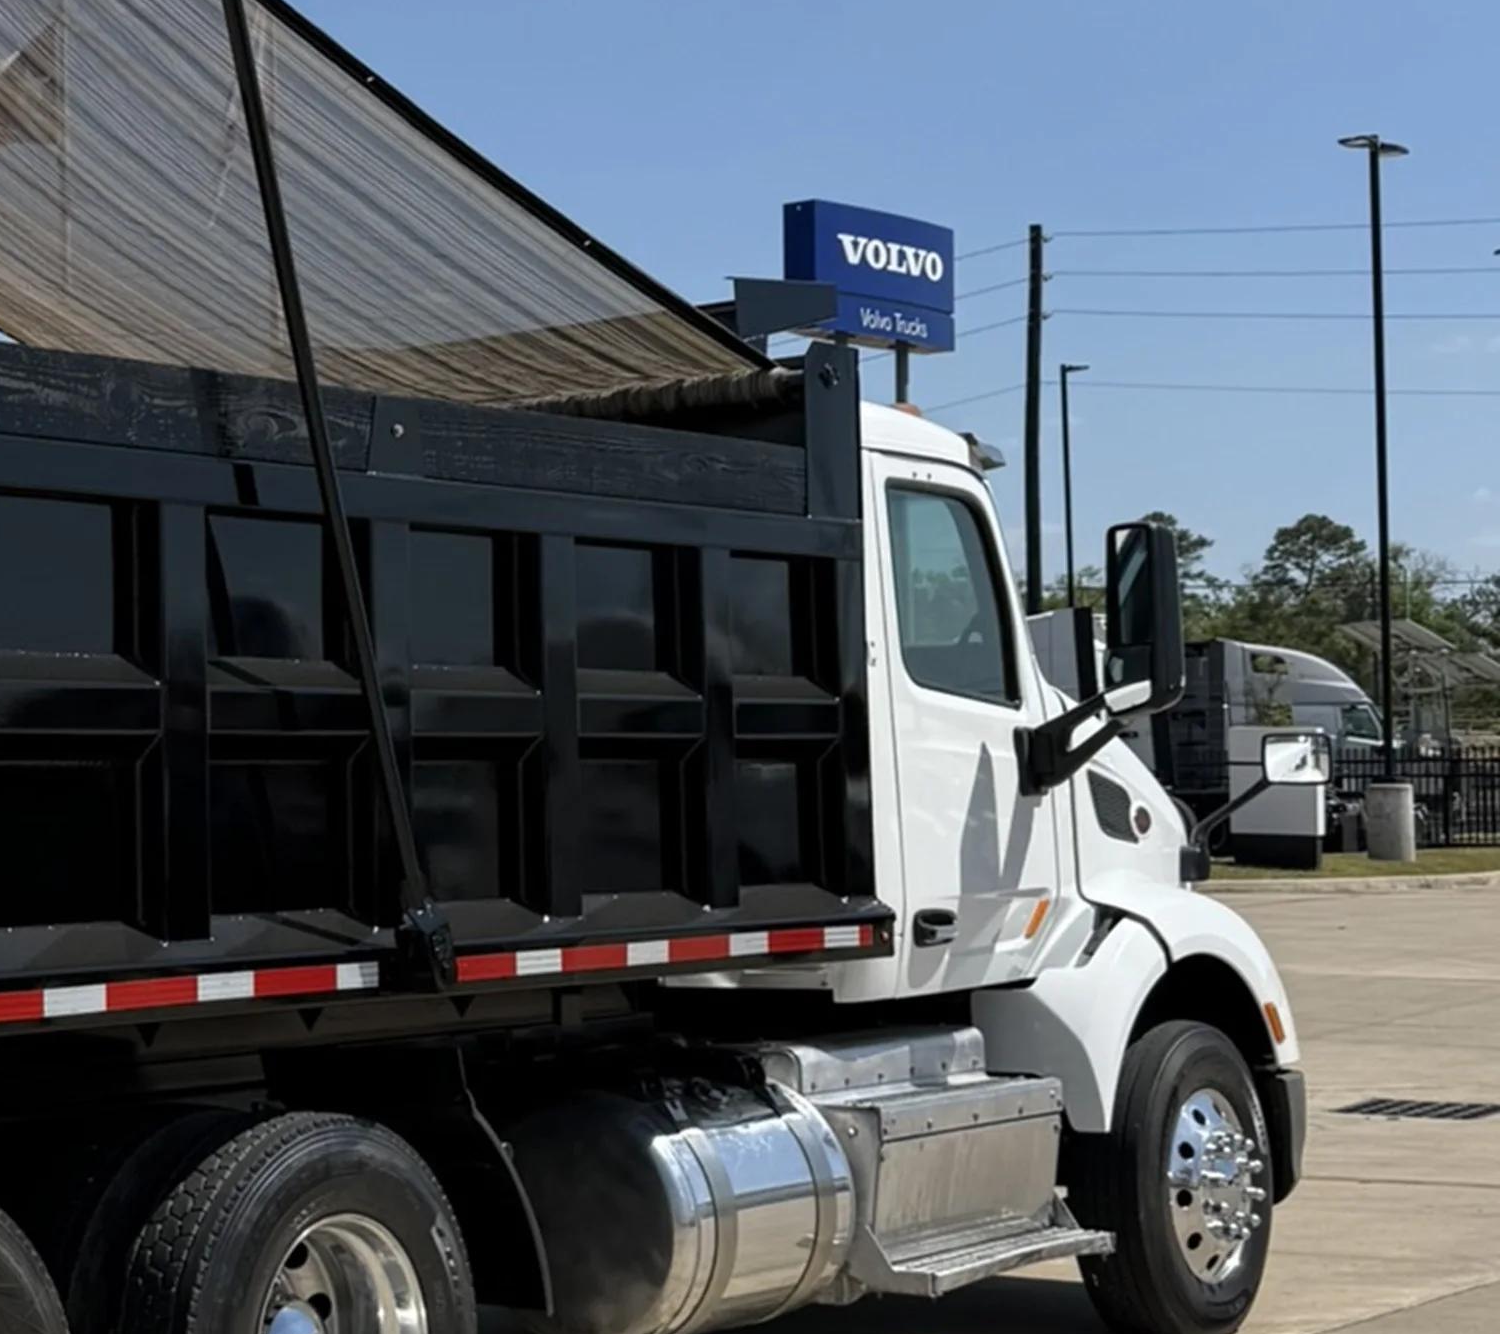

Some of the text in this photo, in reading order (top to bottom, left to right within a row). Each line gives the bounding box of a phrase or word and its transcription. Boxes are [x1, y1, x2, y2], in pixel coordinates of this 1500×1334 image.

[836, 233, 943, 282] VOLVO
[860, 308, 928, 338] Volvo Trucks
